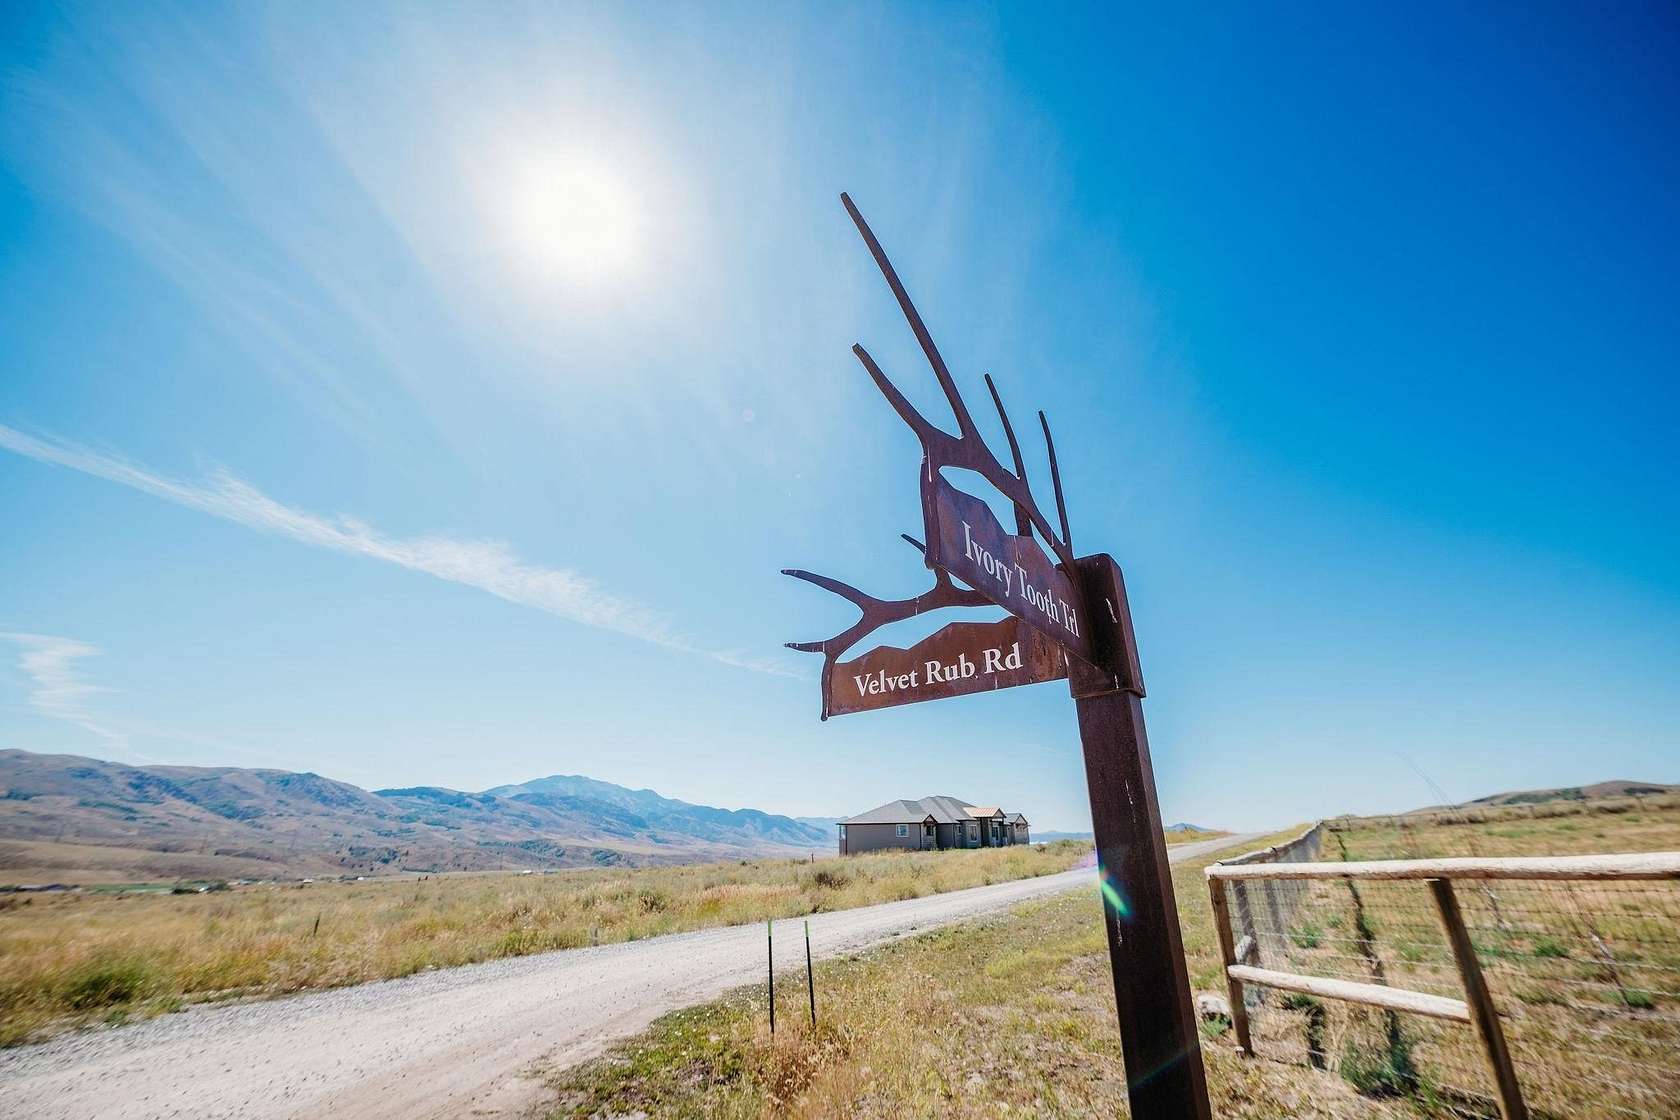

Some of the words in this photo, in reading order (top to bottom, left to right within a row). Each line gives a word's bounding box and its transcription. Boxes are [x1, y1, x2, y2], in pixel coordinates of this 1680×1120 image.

[962, 520, 1012, 597] Ivory
[1014, 563, 1061, 624] Tooth
[853, 669, 919, 697] Velvet
[924, 652, 976, 685] Rub
[982, 641, 1023, 675] Rd
